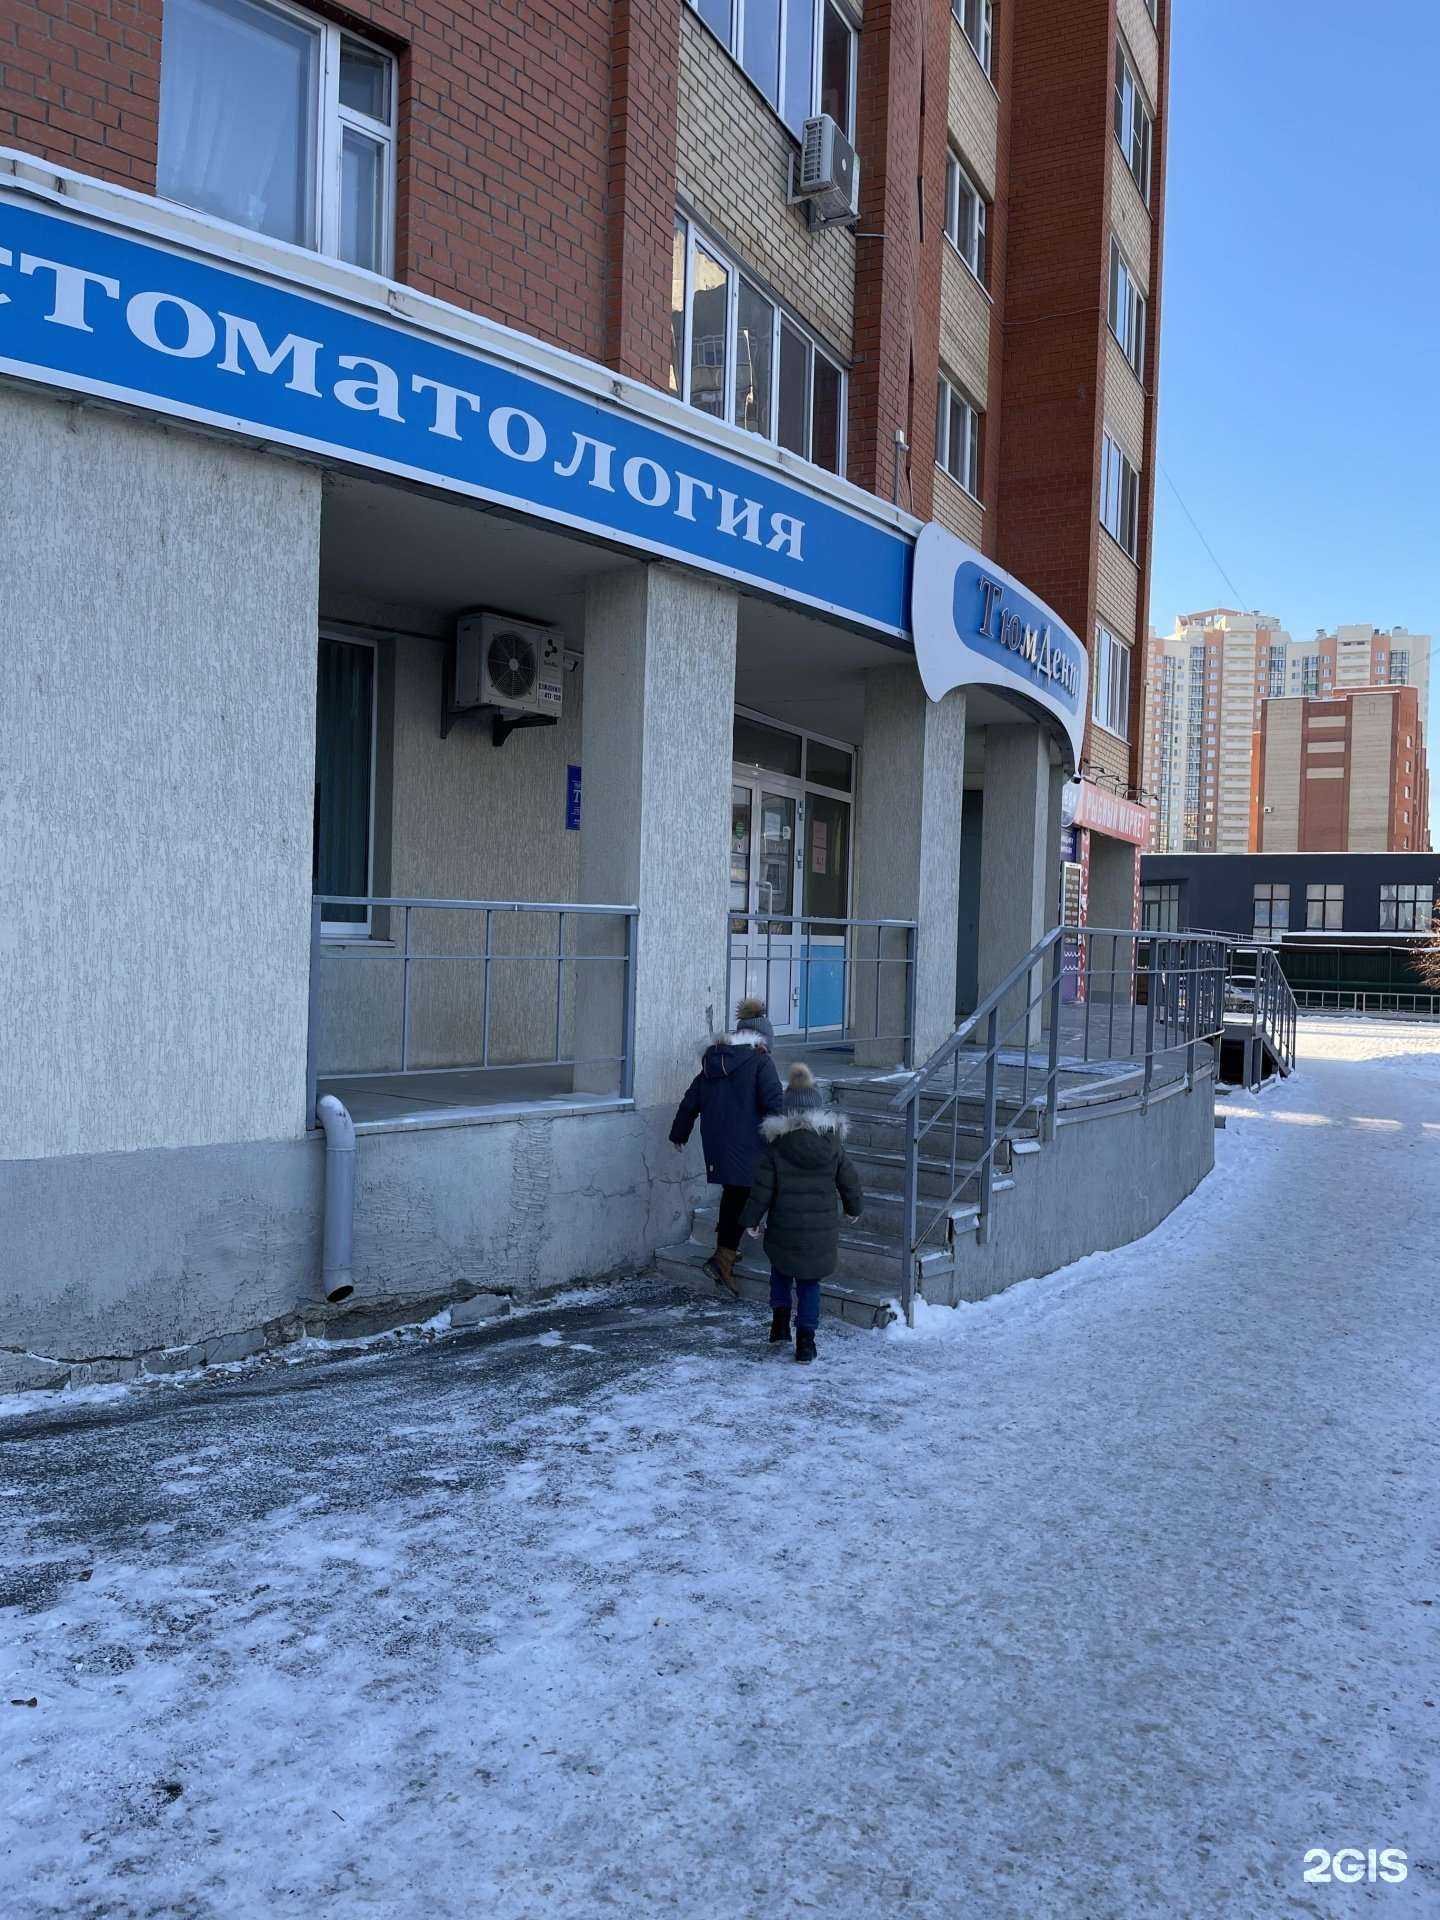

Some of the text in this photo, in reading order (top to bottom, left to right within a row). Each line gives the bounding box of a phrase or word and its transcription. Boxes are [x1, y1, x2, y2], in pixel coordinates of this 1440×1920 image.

[0, 246, 805, 562] томатология
[1087, 790, 1117, 832] РЫБНЫЙ
[1119, 806, 1145, 841] МАРКЕТ
